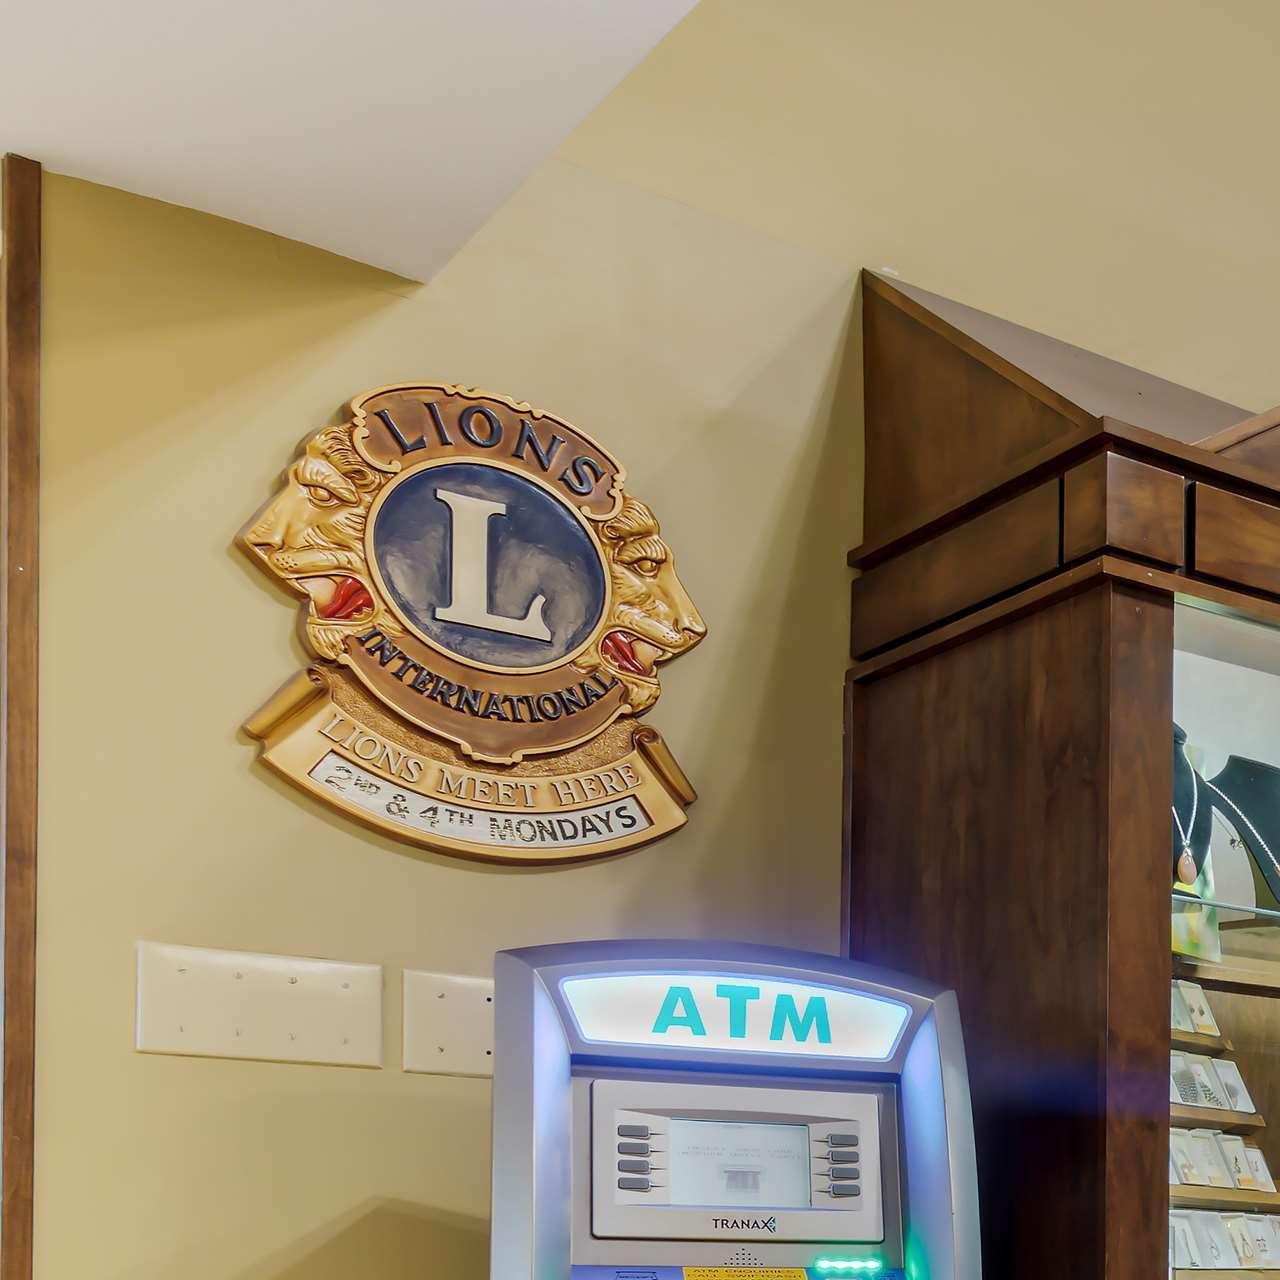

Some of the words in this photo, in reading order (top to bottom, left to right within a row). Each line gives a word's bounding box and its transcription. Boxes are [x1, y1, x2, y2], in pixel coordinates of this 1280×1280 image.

[374, 401, 606, 497] LIONS
[433, 487, 553, 643] L
[354, 626, 620, 723] INTERNATIONAL
[318, 713, 425, 784] LIONS
[436, 768, 538, 807] MEET
[552, 763, 643, 806] HERE
[386, 793, 410, 820] &
[418, 805, 474, 828] 4TH
[488, 806, 638, 843] MONDAYS
[652, 984, 832, 1044] ATM
[712, 1216, 776, 1234] TRANAX
